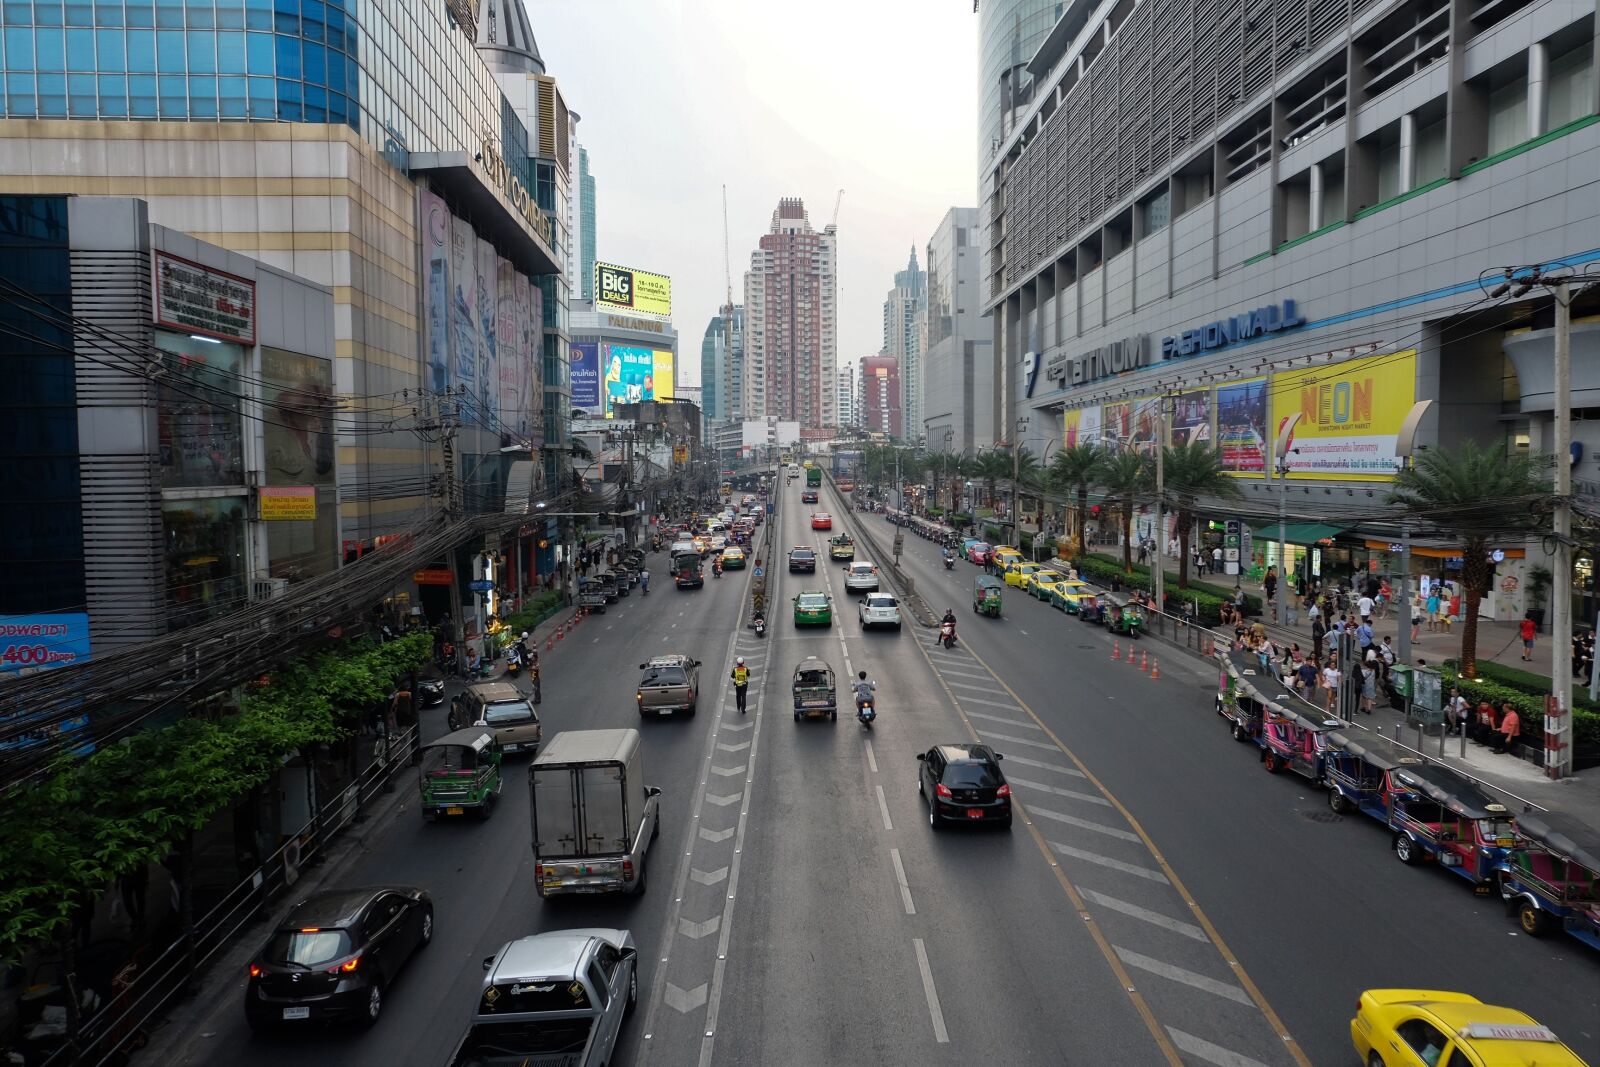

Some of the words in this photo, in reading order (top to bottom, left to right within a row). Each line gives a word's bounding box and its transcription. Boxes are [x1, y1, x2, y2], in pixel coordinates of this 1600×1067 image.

[482, 138, 510, 196] CITY
[512, 175, 553, 249] COMPLEX
[603, 290, 629, 303] DEALS!
[608, 316, 663, 333] PALLADIUM
[1161, 316, 1238, 360] FASHION
[1236, 299, 1306, 341] MALL
[1300, 378, 1373, 425] NEON
[3, 644, 48, 665] 400
